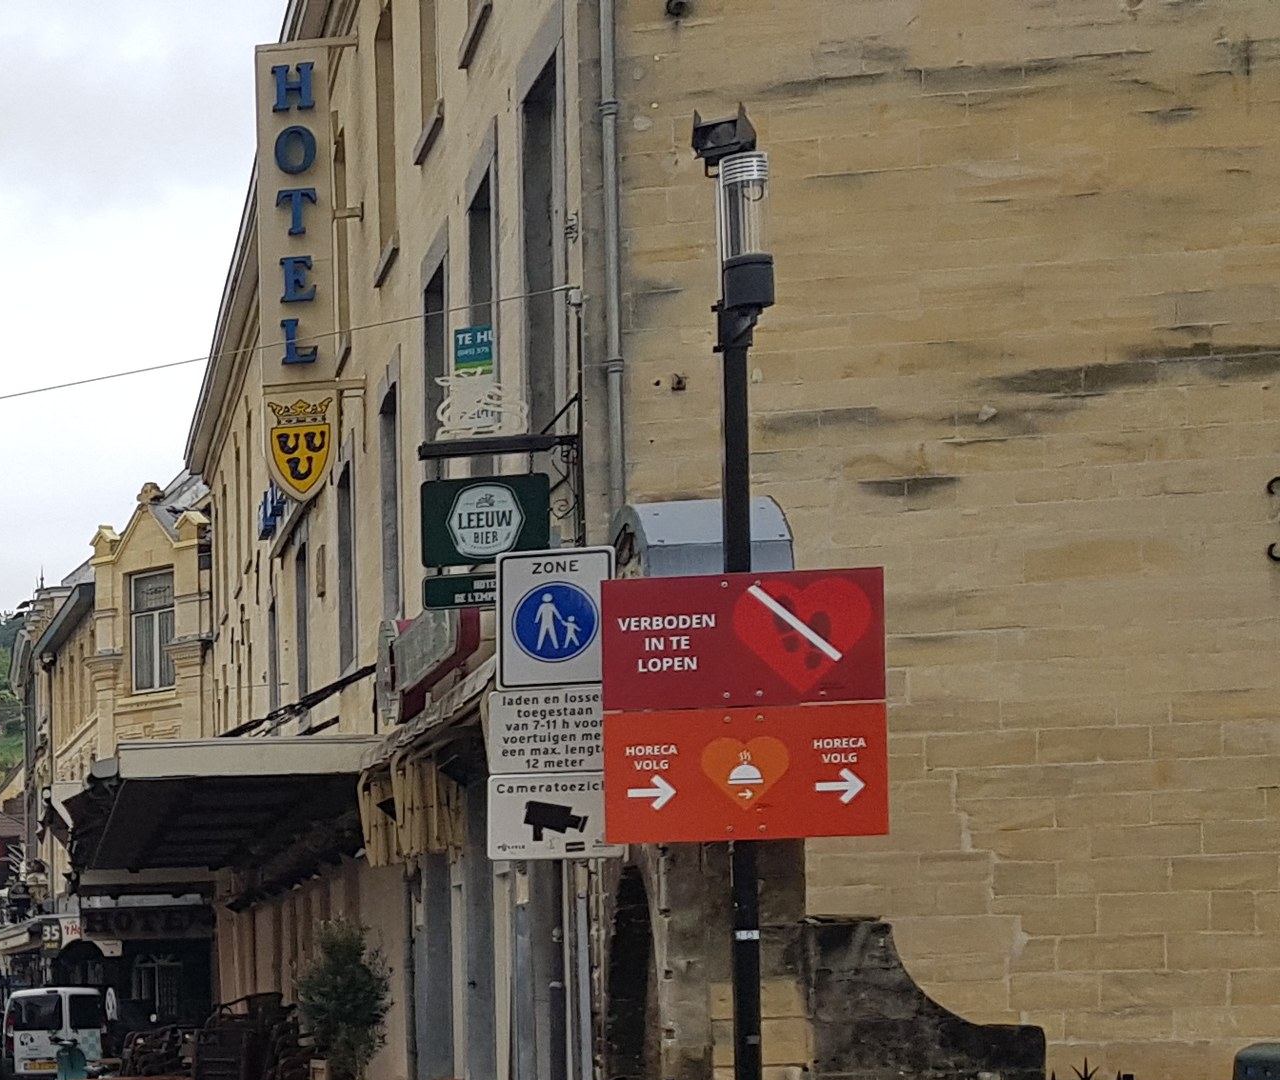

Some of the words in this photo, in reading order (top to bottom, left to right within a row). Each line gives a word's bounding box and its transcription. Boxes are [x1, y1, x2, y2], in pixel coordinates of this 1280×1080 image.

[271, 61, 318, 366] HOTEL
[456, 333, 472, 346] TE
[458, 510, 513, 530] LEEUW
[473, 531, 498, 545] BIER
[532, 560, 579, 575] ZONE
[473, 579, 496, 590] HOTE
[617, 614, 716, 632] VERBODEN
[645, 637, 664, 651] IN
[670, 635, 690, 650] TE
[638, 657, 698, 673] LOPEN
[502, 694, 539, 706] laden
[544, 695, 560, 705] en
[564, 693, 602, 704] losse
[517, 706, 593, 719] toegestaan
[506, 722, 528, 731] van
[533, 720, 557, 730] 7-11
[562, 719, 570, 729] h
[502, 732, 577, 745] voertuigen
[581, 732, 601, 742] me
[813, 738, 866, 750] HORECA
[502, 748, 525, 757] een
[530, 746, 561, 756] max.
[565, 744, 604, 757] lengt
[626, 744, 678, 756] HORECA
[525, 759, 539, 769] 12
[544, 758, 585, 768] meter
[822, 753, 858, 764] VOLG
[634, 760, 669, 771] VOLG
[496, 781, 604, 794] Cameratoezic
[42, 925, 60, 940] 35
